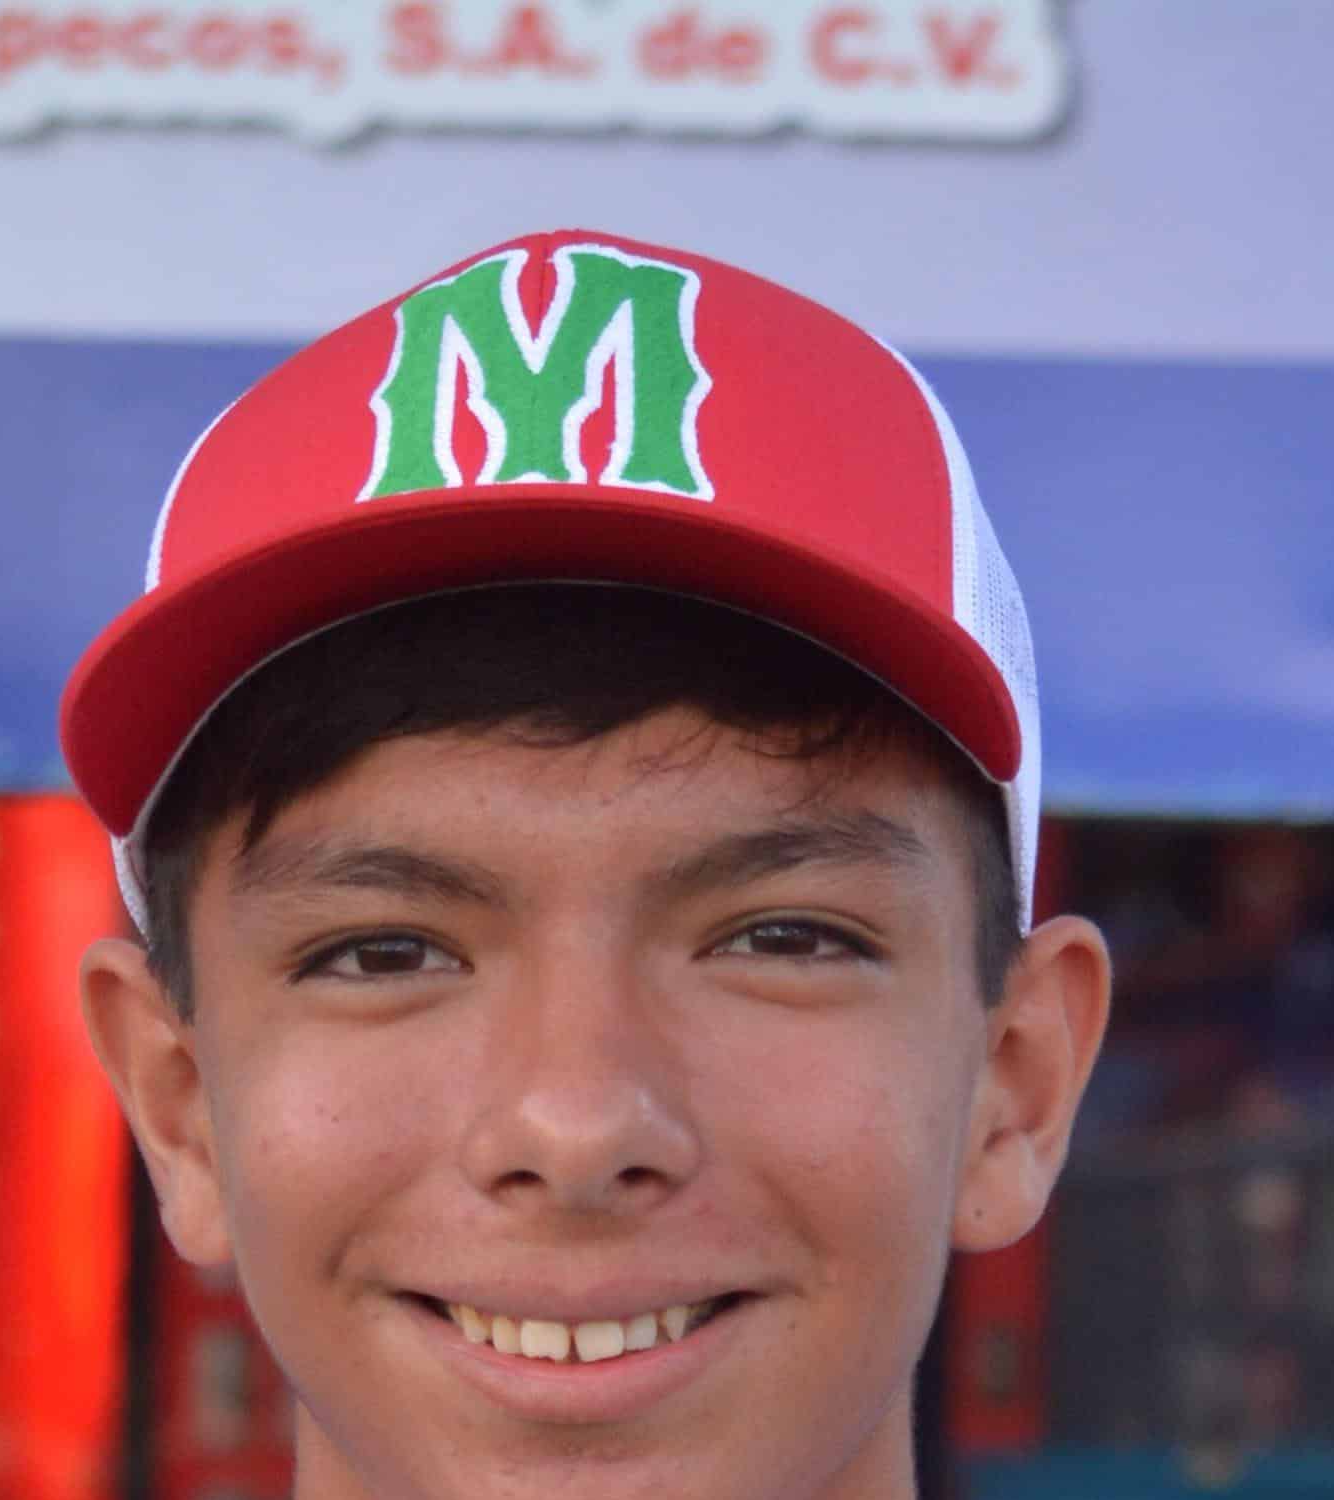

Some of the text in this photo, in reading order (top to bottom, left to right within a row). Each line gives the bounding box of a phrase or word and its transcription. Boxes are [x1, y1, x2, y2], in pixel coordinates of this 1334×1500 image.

[381, 1, 601, 77] S.A.
[636, 12, 770, 83] de
[806, 5, 1024, 88] C.V.
[355, 244, 716, 503] M
